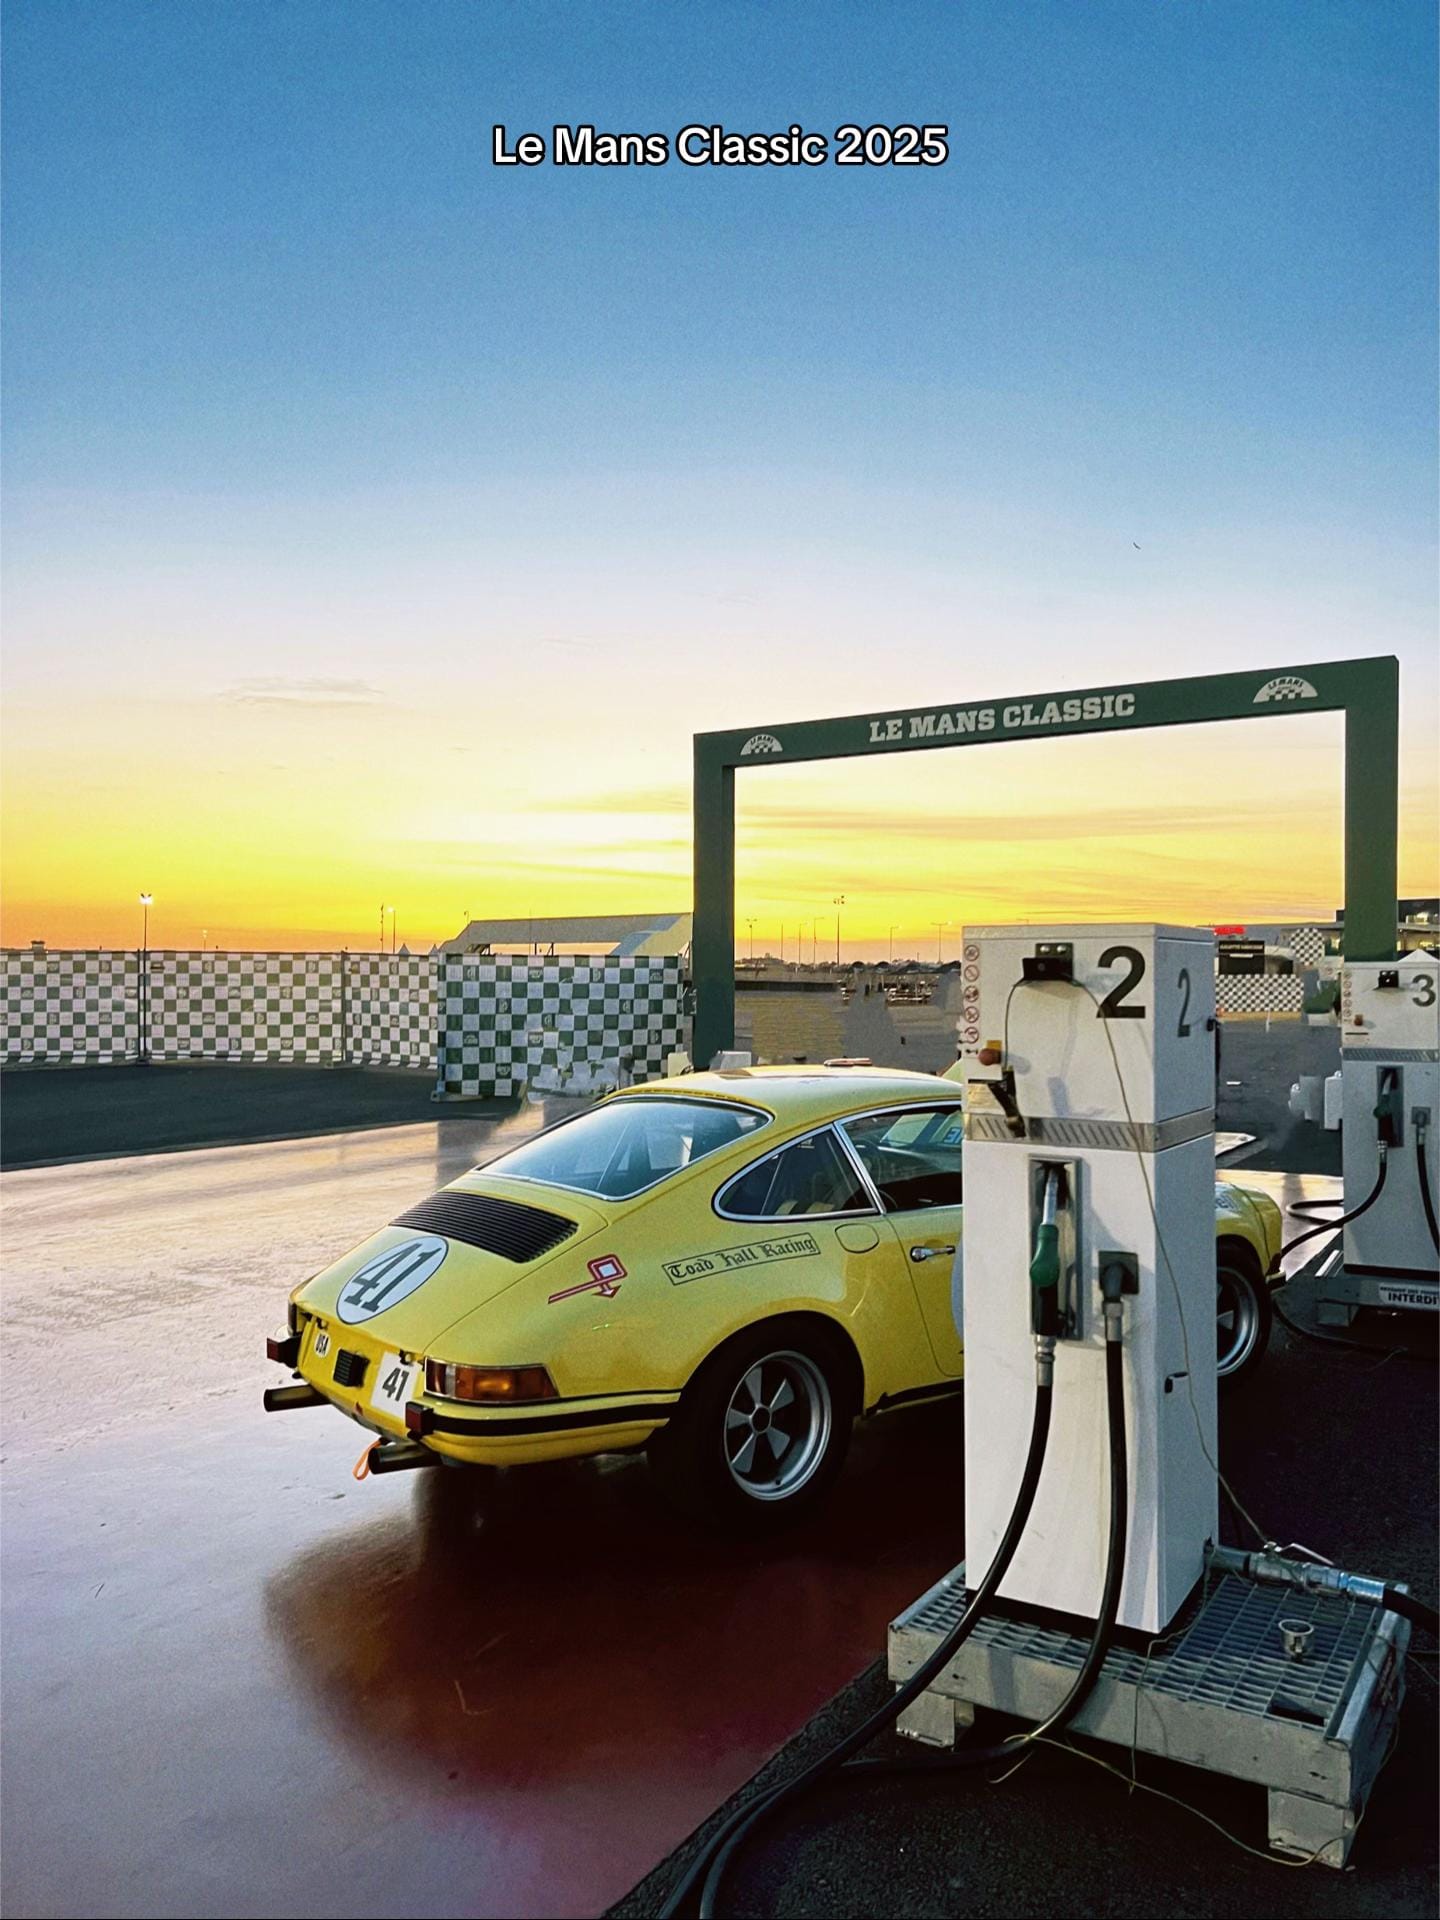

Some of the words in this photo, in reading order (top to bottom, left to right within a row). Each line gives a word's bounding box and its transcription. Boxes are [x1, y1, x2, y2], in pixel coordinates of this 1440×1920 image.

[869, 719, 903, 743] LE
[908, 708, 996, 738] MANS
[1002, 693, 1136, 728] CLASSIC
[1096, 945, 1146, 1018] 2
[1177, 967, 1191, 1037] 2
[1412, 974, 1437, 1008] 3
[343, 1242, 442, 1313] 41
[667, 1258, 715, 1279] Toad
[758, 1238, 816, 1258] Racing
[1388, 1291, 1440, 1306] INTERDI
[382, 1366, 410, 1402] 41
